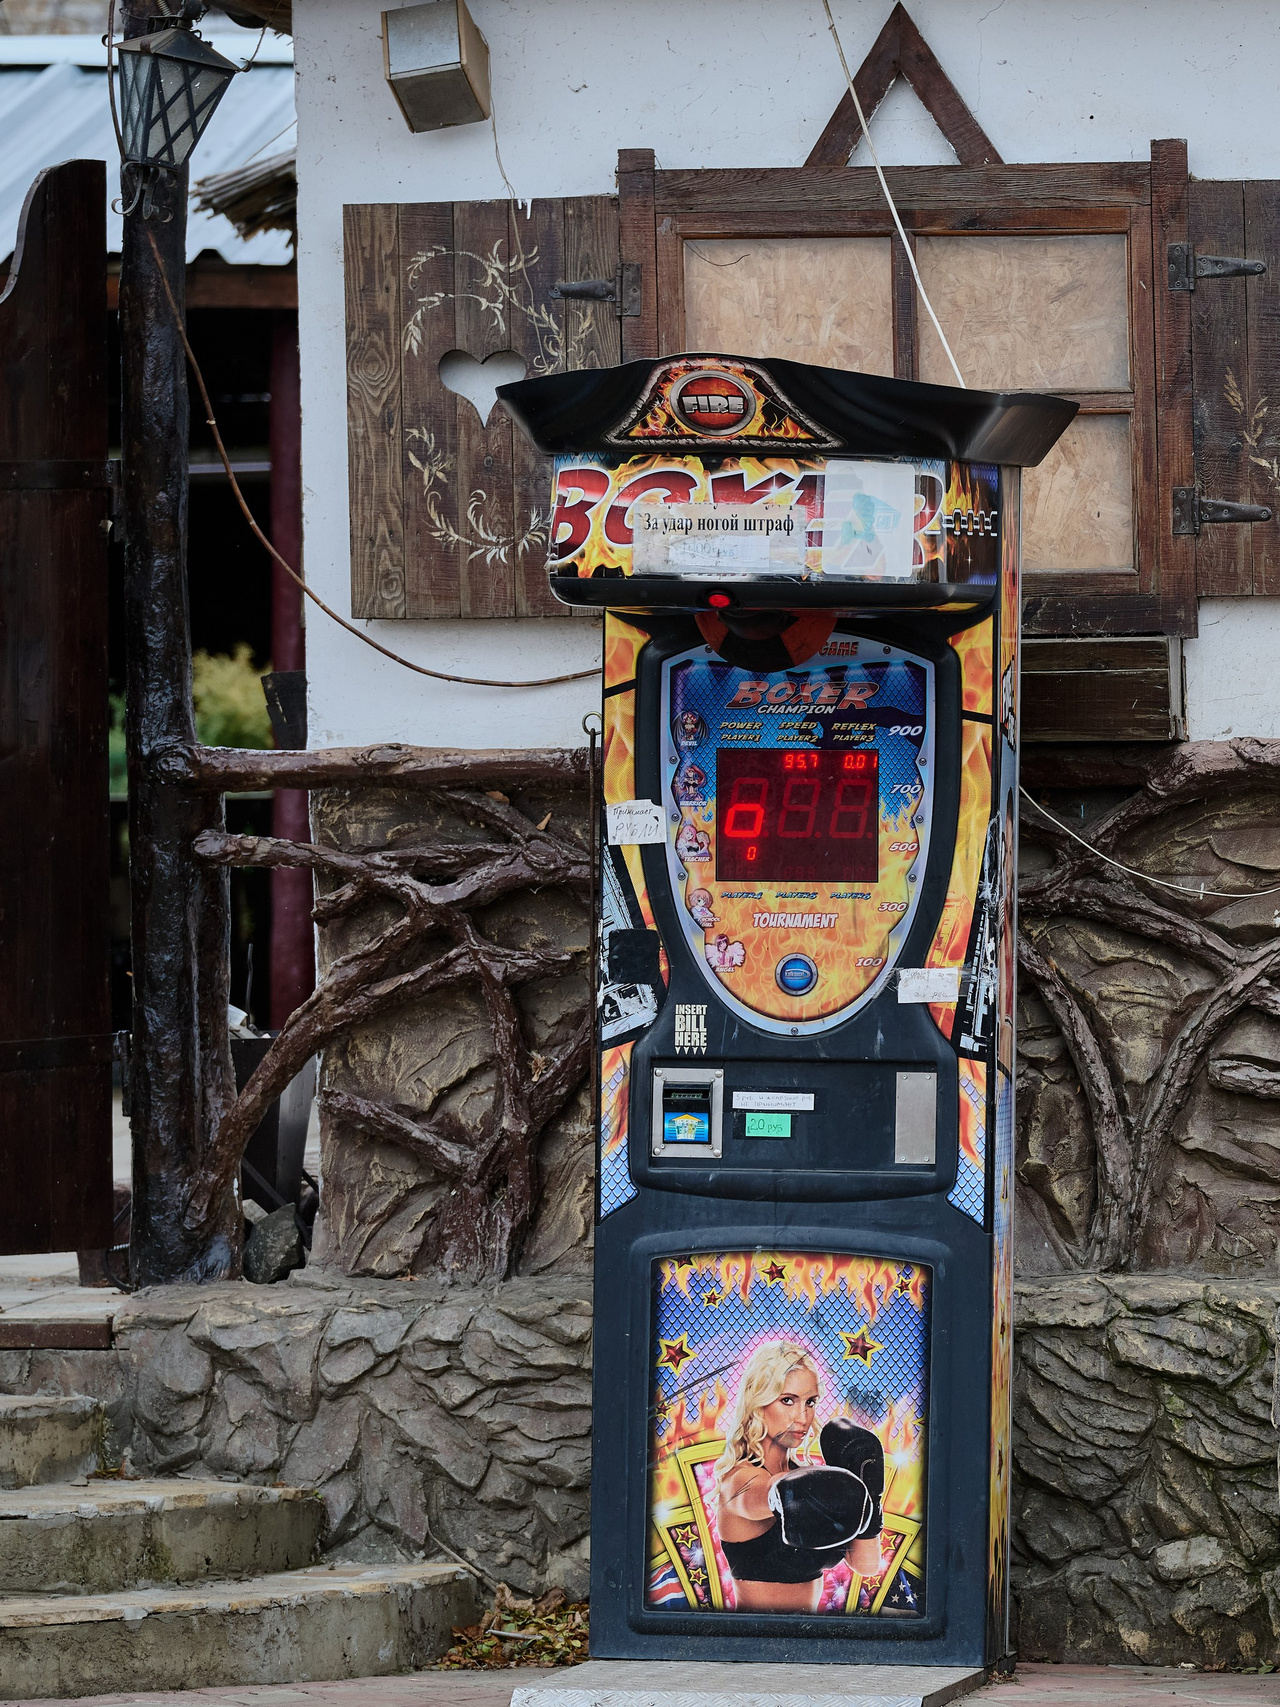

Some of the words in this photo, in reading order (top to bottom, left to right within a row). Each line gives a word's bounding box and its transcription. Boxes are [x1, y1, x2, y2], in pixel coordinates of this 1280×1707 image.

[682, 395, 744, 414] FIRE
[643, 513, 658, 531] За
[662, 517, 693, 536] удар
[697, 514, 739, 531] ногой
[743, 514, 794, 536] штраф
[725, 681, 879, 710] BOXER
[757, 704, 836, 715] CHAMPION
[720, 721, 762, 730] POWER
[778, 721, 817, 730] SPEED
[831, 723, 877, 731] REFLEX
[887, 725, 923, 737] 900
[890, 784, 922, 795] 700
[888, 842, 919, 852] 500
[746, 846, 757, 861] 0
[878, 902, 909, 912] 300
[753, 912, 838, 929] TOURNAMENT
[855, 957, 883, 968] 100
[675, 1004, 707, 1015] INSERT
[675, 1015, 707, 1032] BILL
[675, 1032, 707, 1046] HERE
